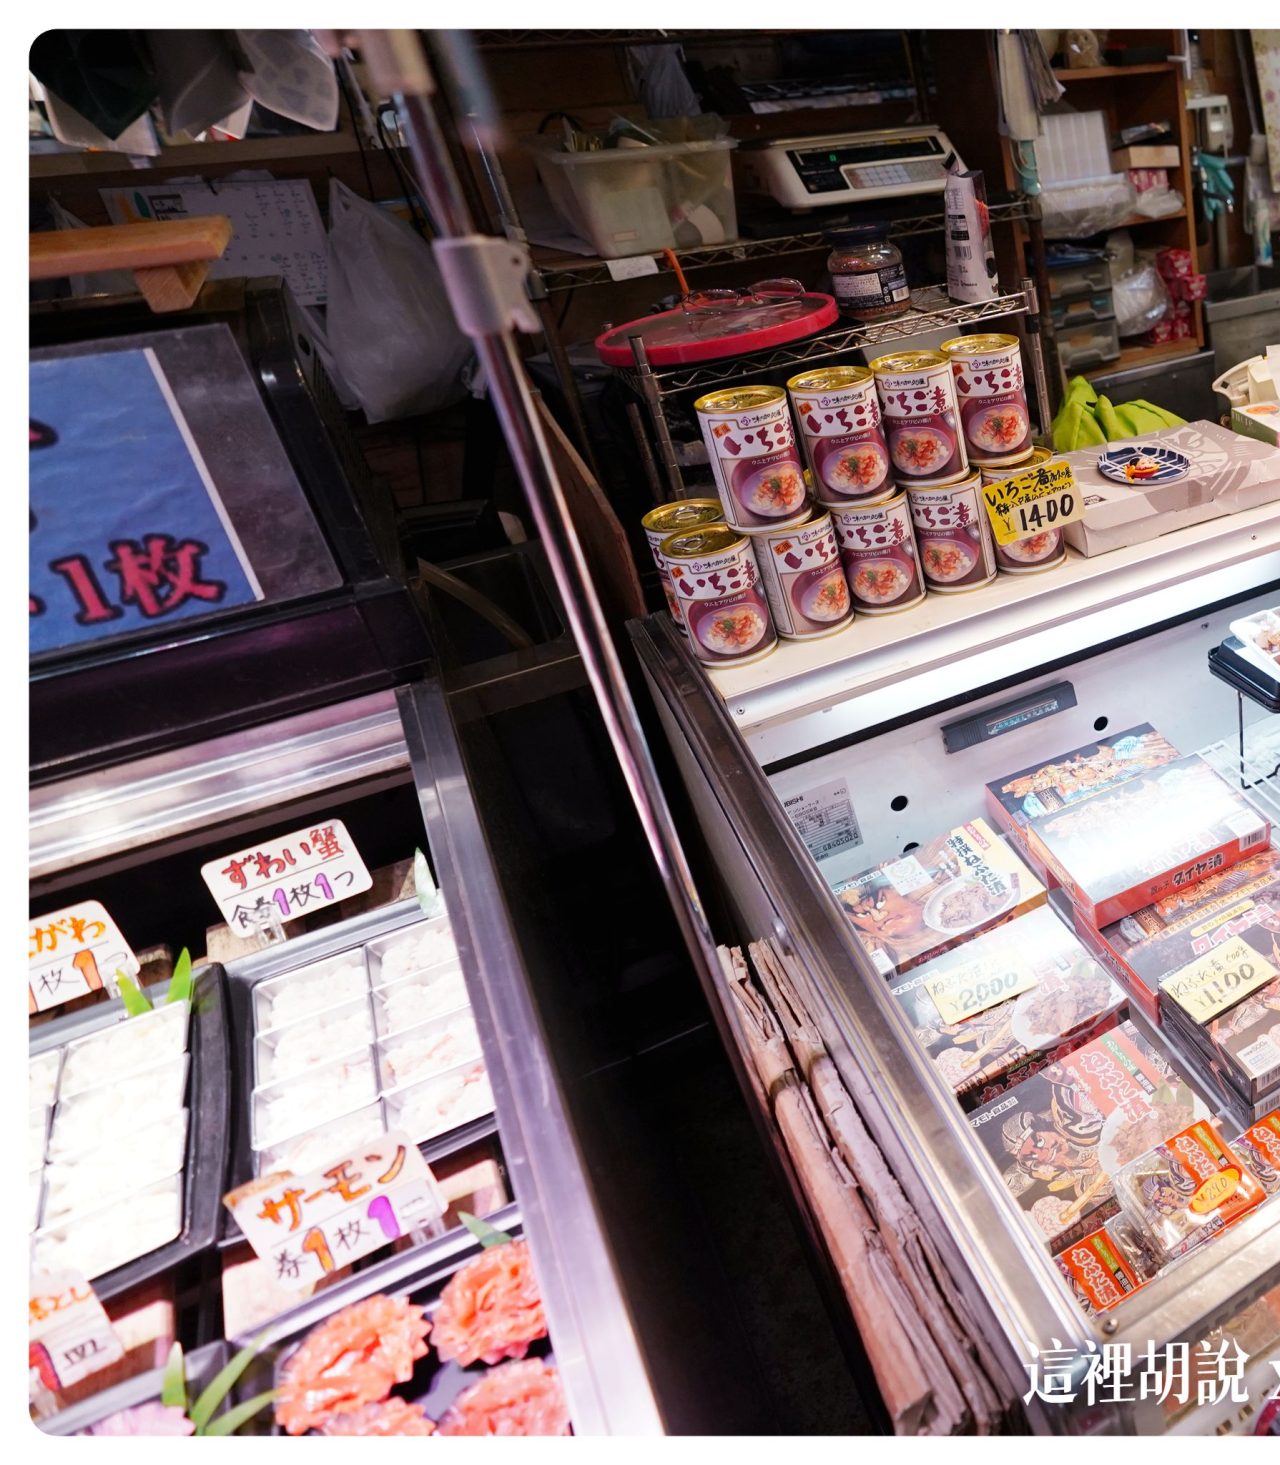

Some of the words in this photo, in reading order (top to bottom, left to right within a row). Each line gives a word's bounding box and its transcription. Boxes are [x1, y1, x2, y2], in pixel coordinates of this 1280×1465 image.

[957, 366, 1022, 395] いちご煮
[806, 398, 880, 434] いちご煮
[723, 416, 796, 456] いちご煮
[679, 559, 757, 597] いちご煮
[221, 825, 344, 890] ずわい蟹
[1172, 853, 1226, 886] ダイヤ漬
[29, 916, 107, 959] がわ
[257, 1144, 406, 1232] サーモン
